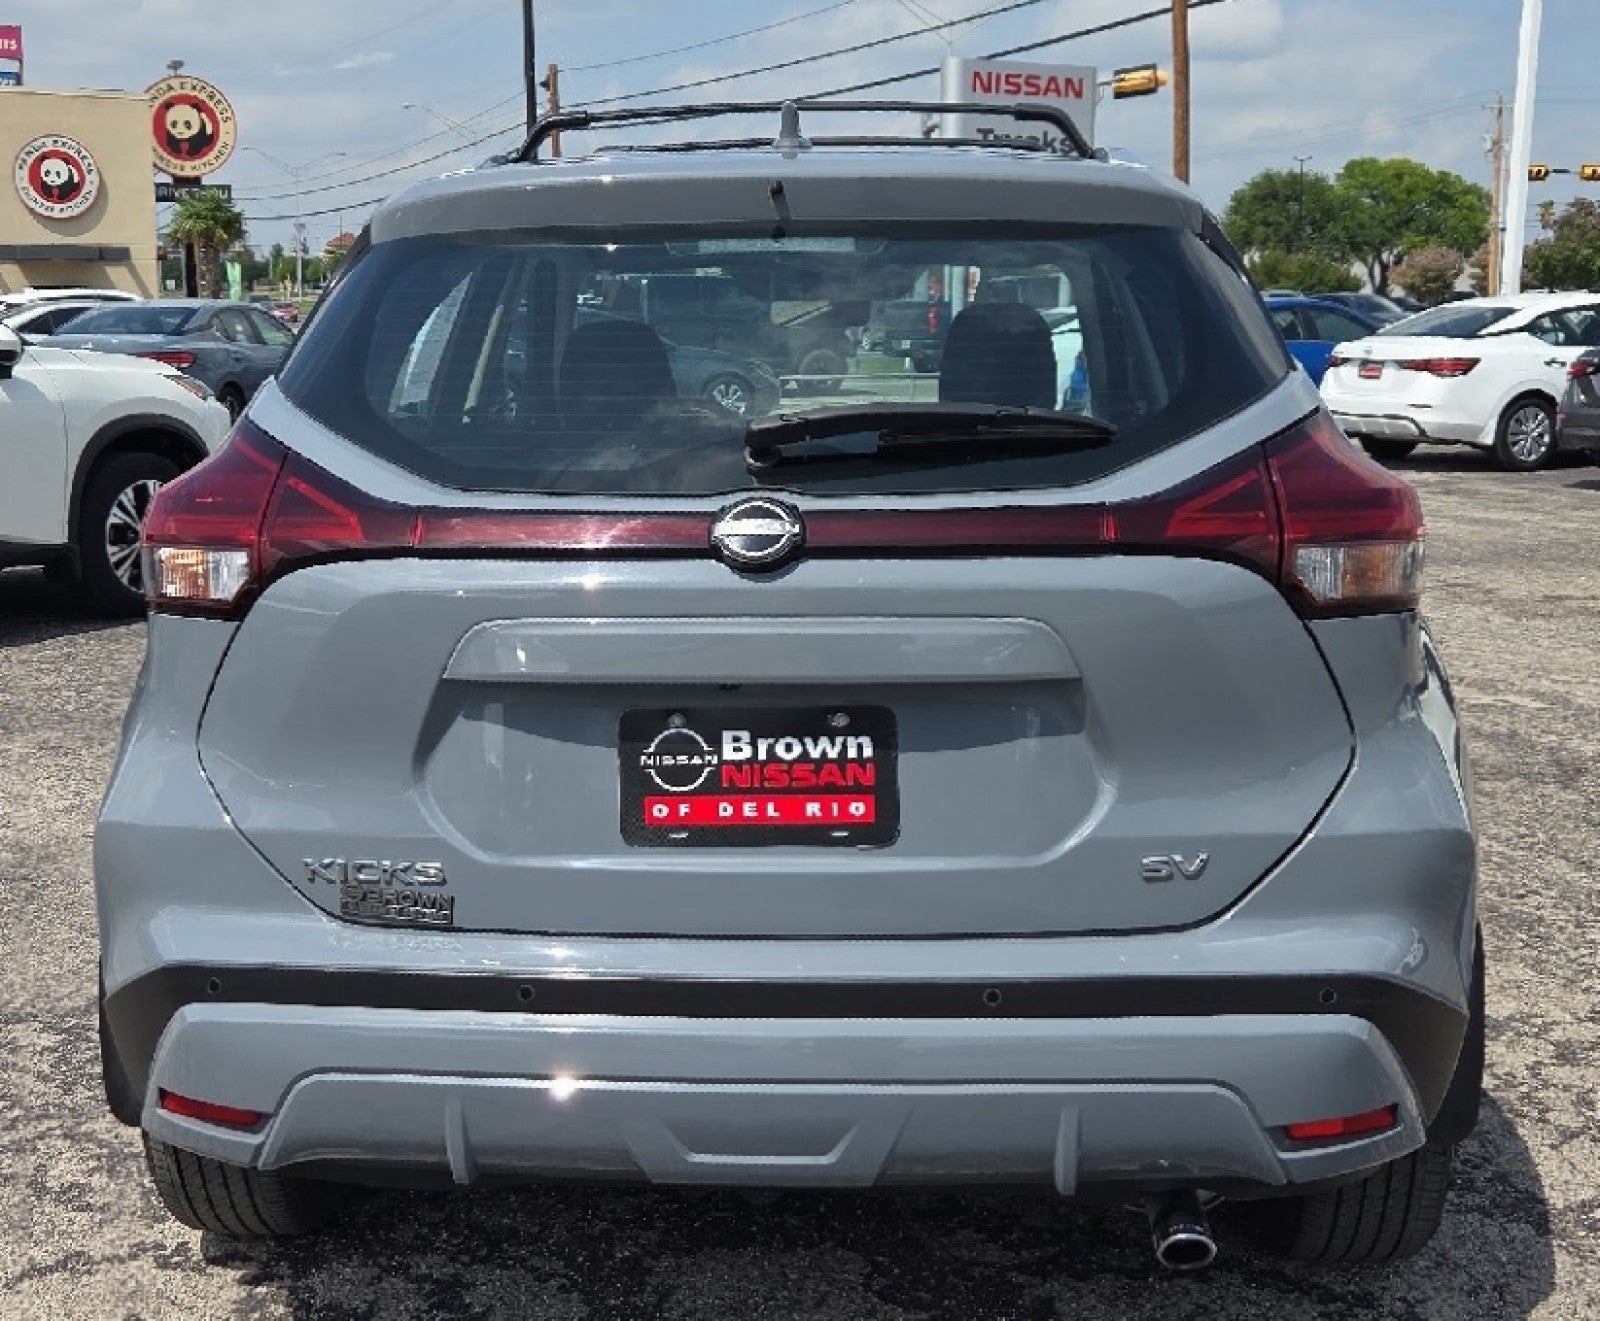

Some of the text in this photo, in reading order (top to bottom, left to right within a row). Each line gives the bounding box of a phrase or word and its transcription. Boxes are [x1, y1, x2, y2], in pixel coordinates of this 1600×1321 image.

[971, 70, 1084, 99] NISSAN
[180, 80, 232, 123] EXPRESS
[721, 729, 874, 761] Brown
[640, 754, 718, 767] NISSAN
[721, 762, 876, 788] NISSAN
[651, 801, 866, 818] OF DEL RIO
[302, 858, 448, 886] KICKS
[1141, 851, 1211, 882] SV
